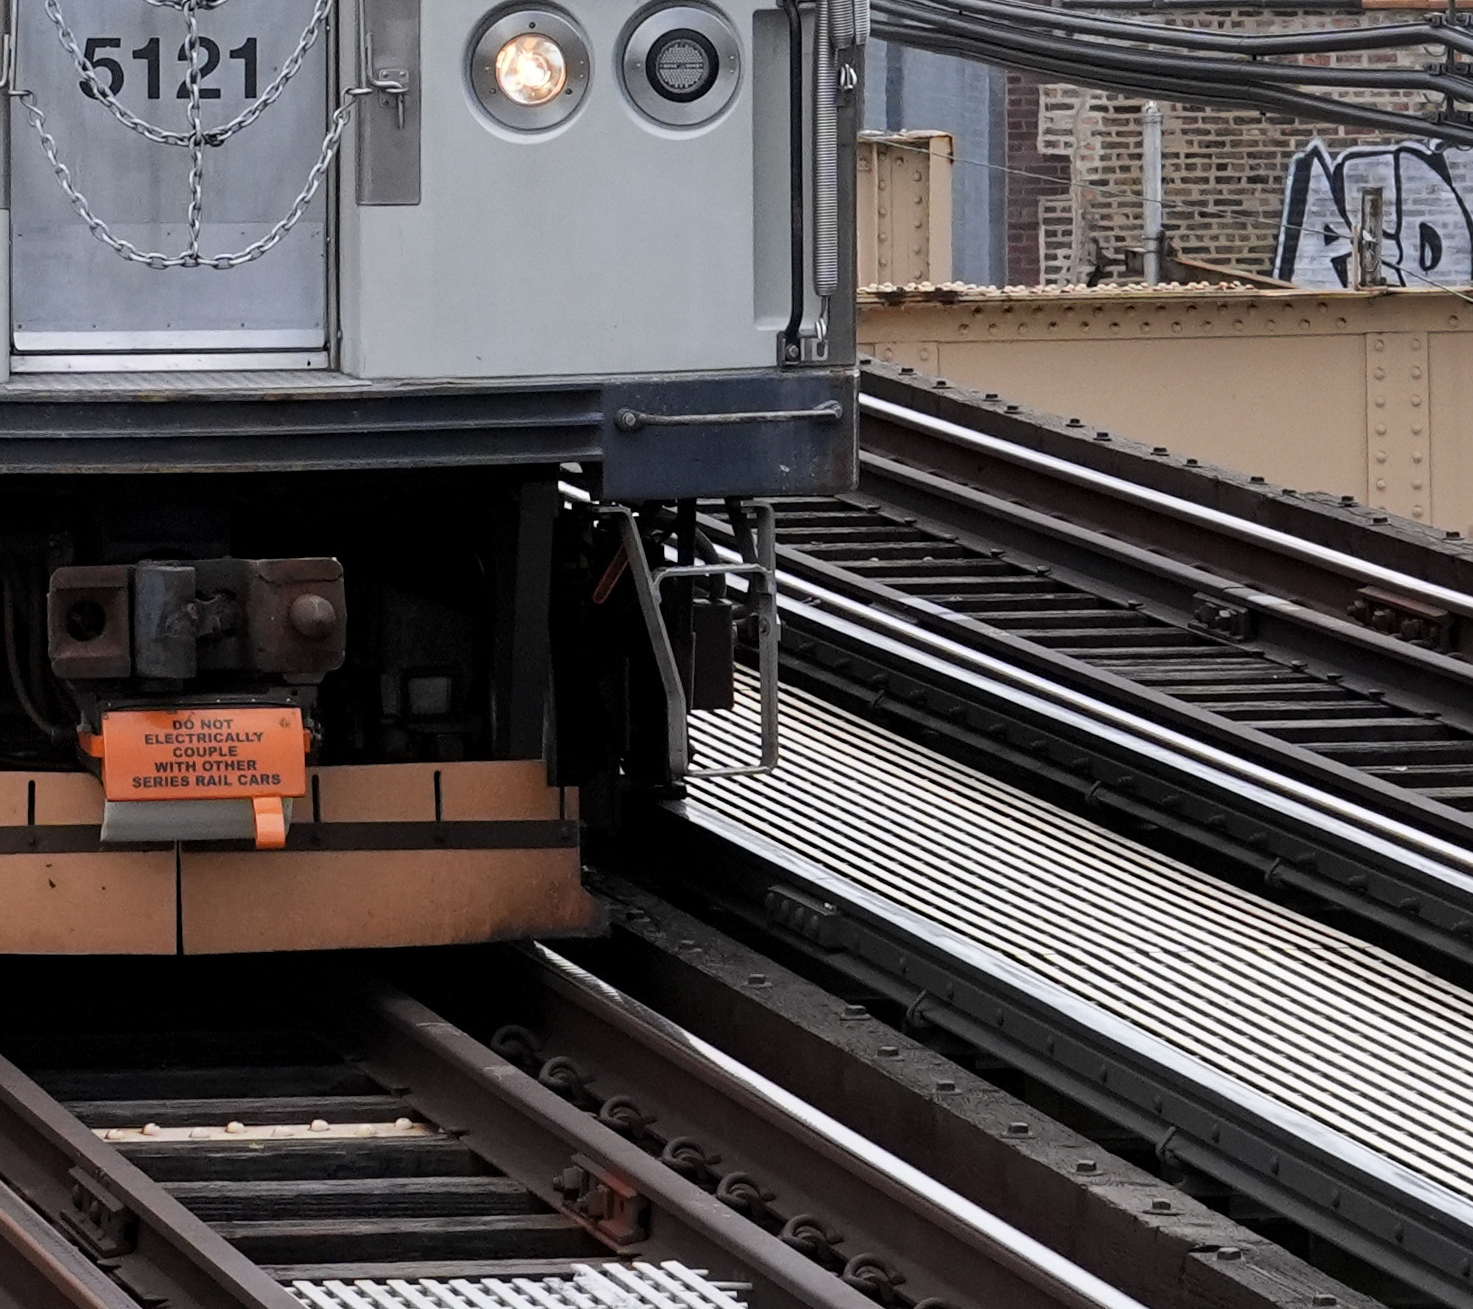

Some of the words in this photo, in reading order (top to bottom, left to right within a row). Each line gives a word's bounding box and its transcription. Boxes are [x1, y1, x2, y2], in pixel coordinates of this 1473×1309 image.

[78, 36, 259, 101] 5121
[172, 719, 195, 731] DO
[200, 718, 235, 730] NOT
[144, 731, 264, 745] ELECTRICALLY
[172, 745, 238, 758] COUPLE
[154, 760, 197, 774] WITH
[201, 759, 258, 772] OTHER
[132, 774, 190, 789] SERIES
[195, 774, 233, 787] RAIL
[237, 773, 282, 786] CARS
